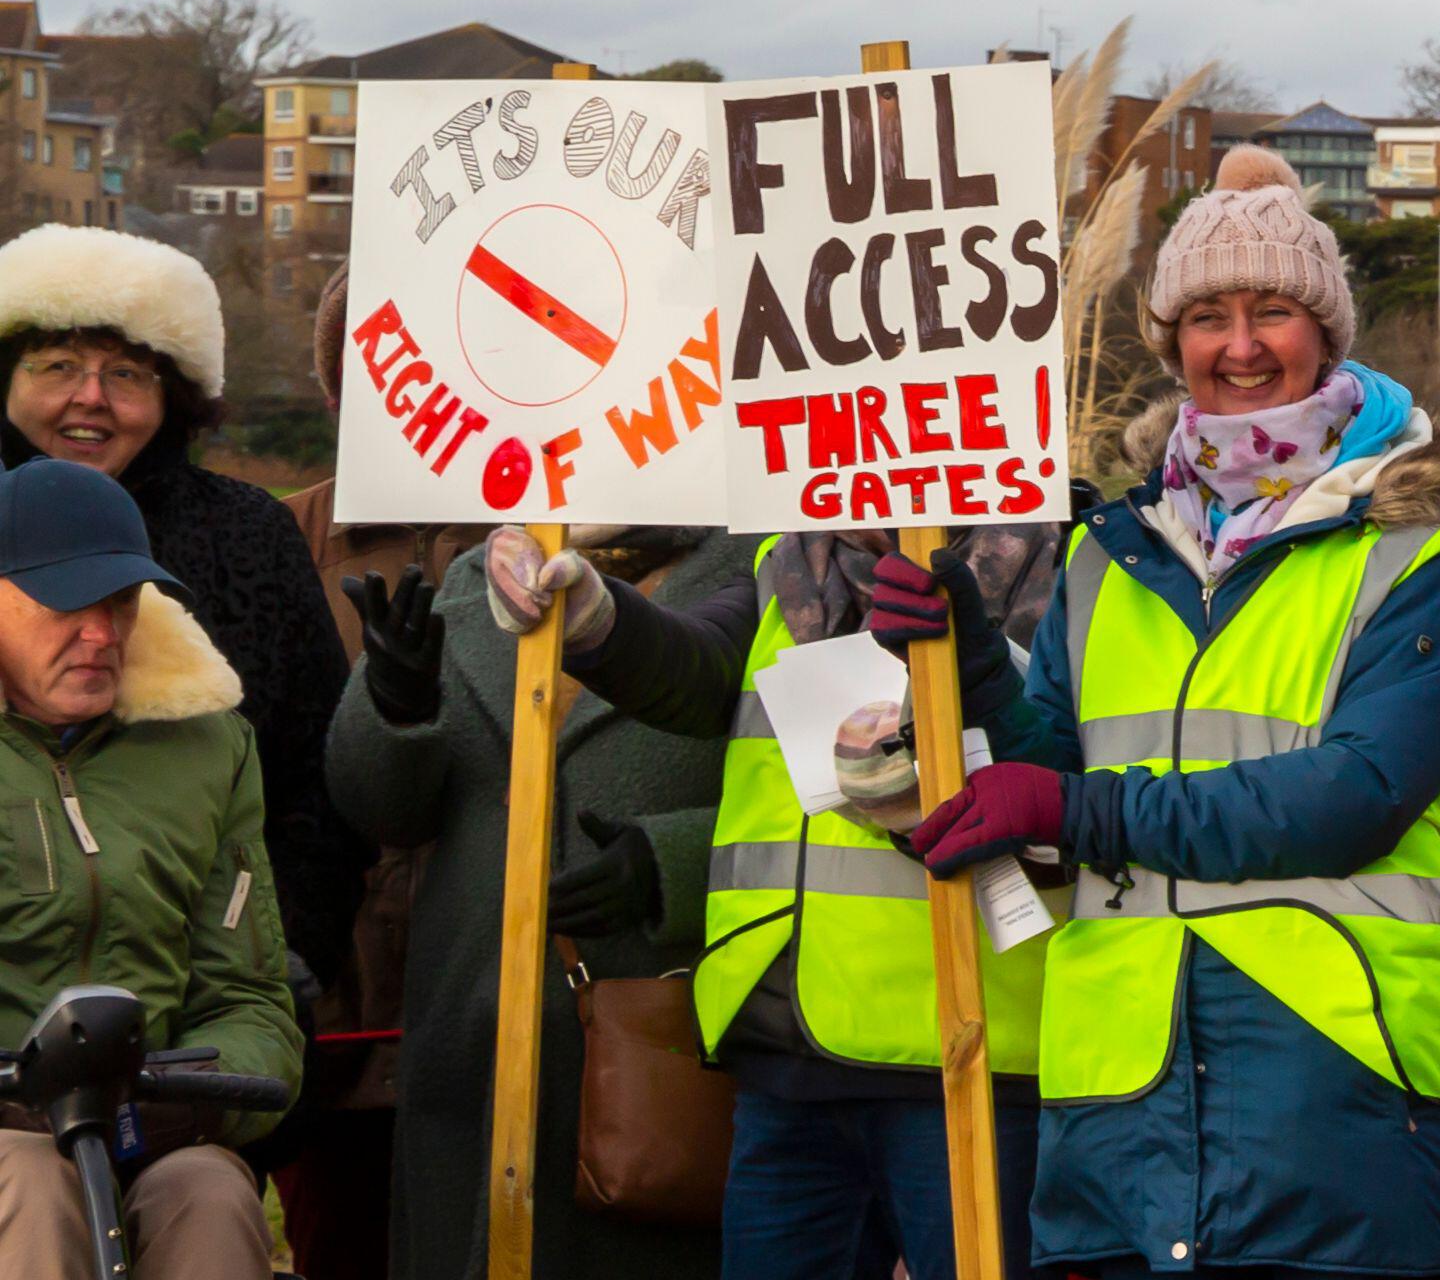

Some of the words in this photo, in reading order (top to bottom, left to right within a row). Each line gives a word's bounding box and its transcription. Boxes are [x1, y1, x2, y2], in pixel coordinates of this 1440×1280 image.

[390, 89, 539, 244] IT'S
[563, 96, 711, 251] OUR
[723, 73, 998, 235] FULL
[731, 219, 1060, 381] ACCESS
[351, 298, 490, 477] RIGHT
[481, 427, 583, 511] OF
[604, 306, 723, 469] WAY
